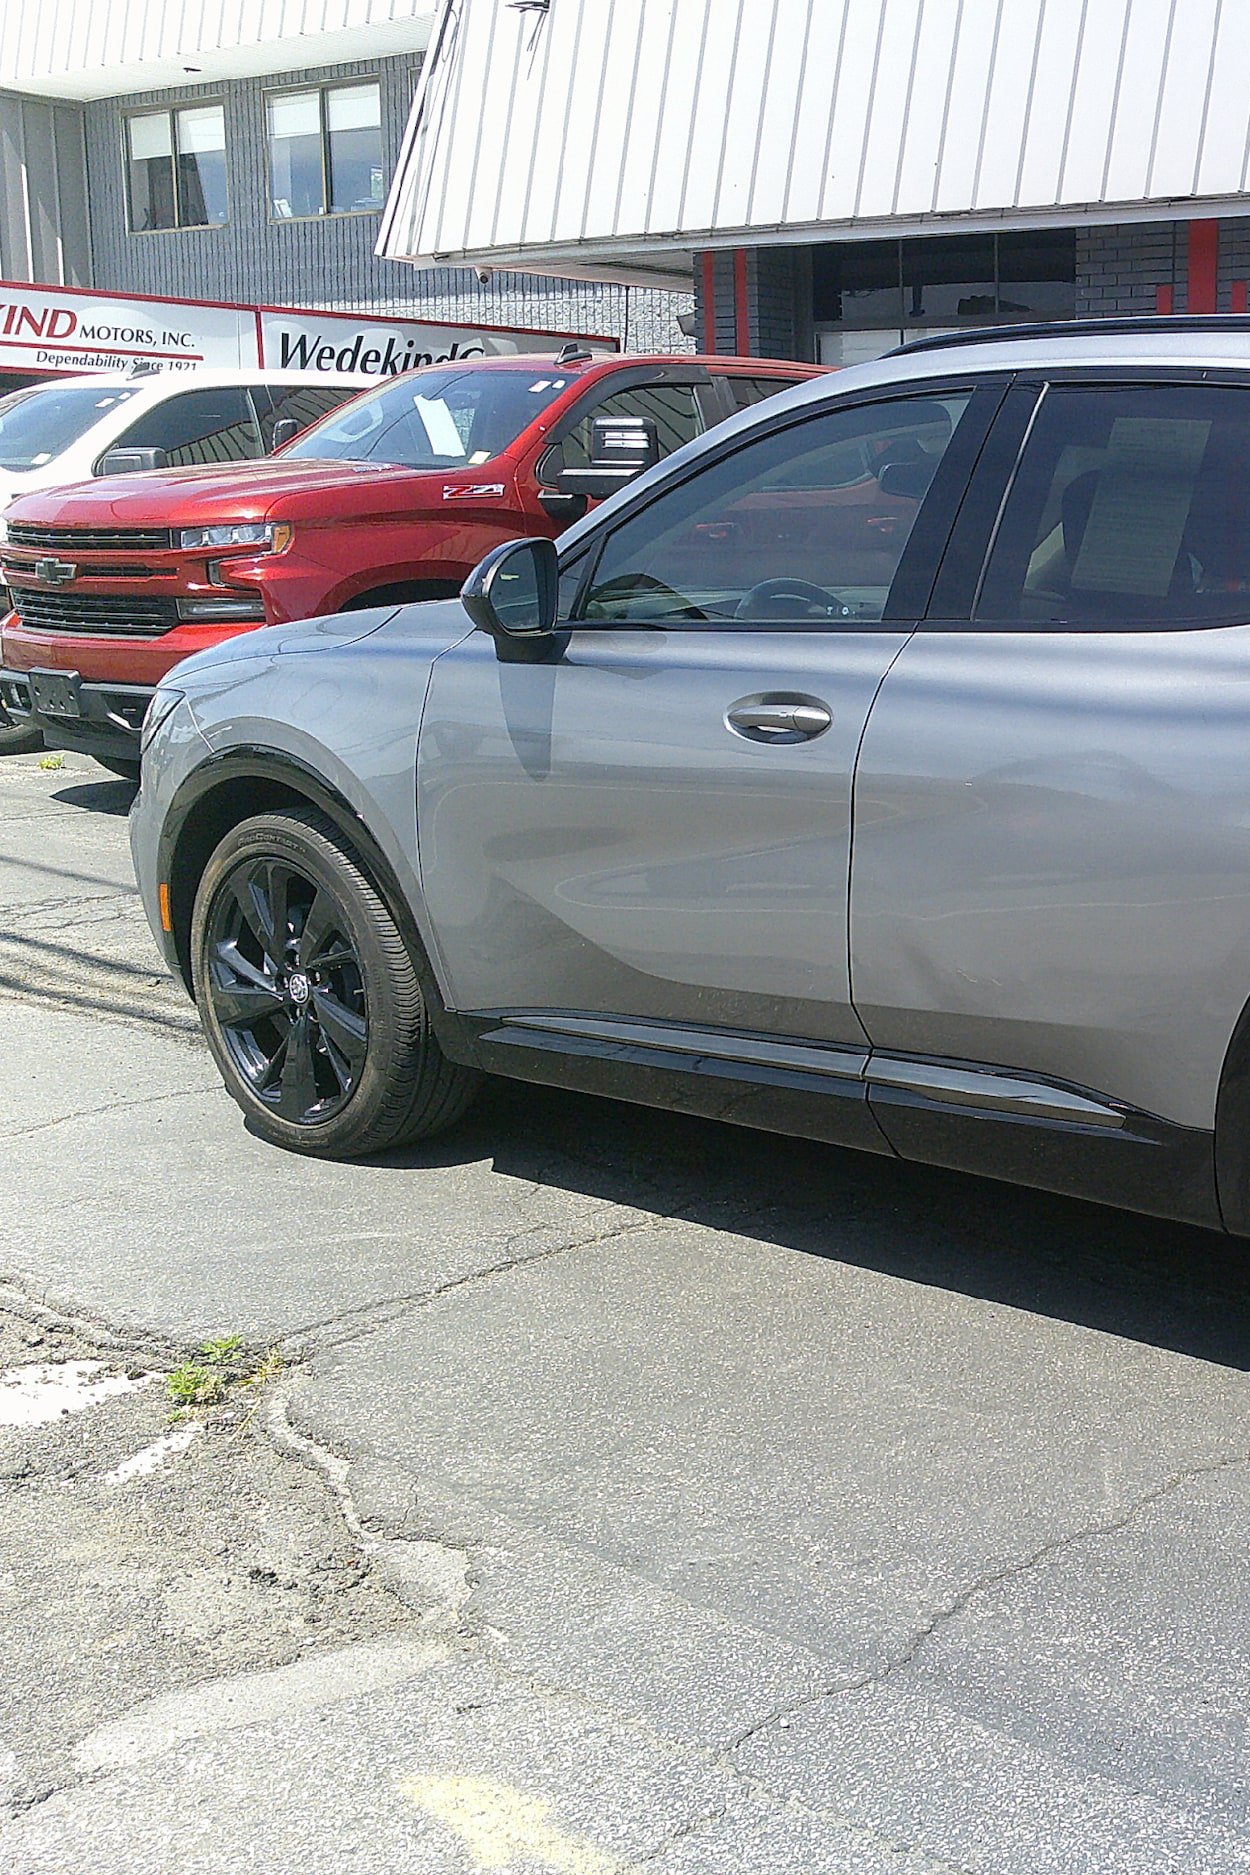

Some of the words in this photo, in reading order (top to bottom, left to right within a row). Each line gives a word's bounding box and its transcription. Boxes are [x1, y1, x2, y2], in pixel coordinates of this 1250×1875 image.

[0, 304, 77, 338] IND
[80, 325, 157, 347] MOTORS,
[162, 331, 195, 347] INC.
[36, 351, 127, 371] Dependability
[168, 360, 197, 371] 1921
[281, 333, 484, 374] Wedekin
